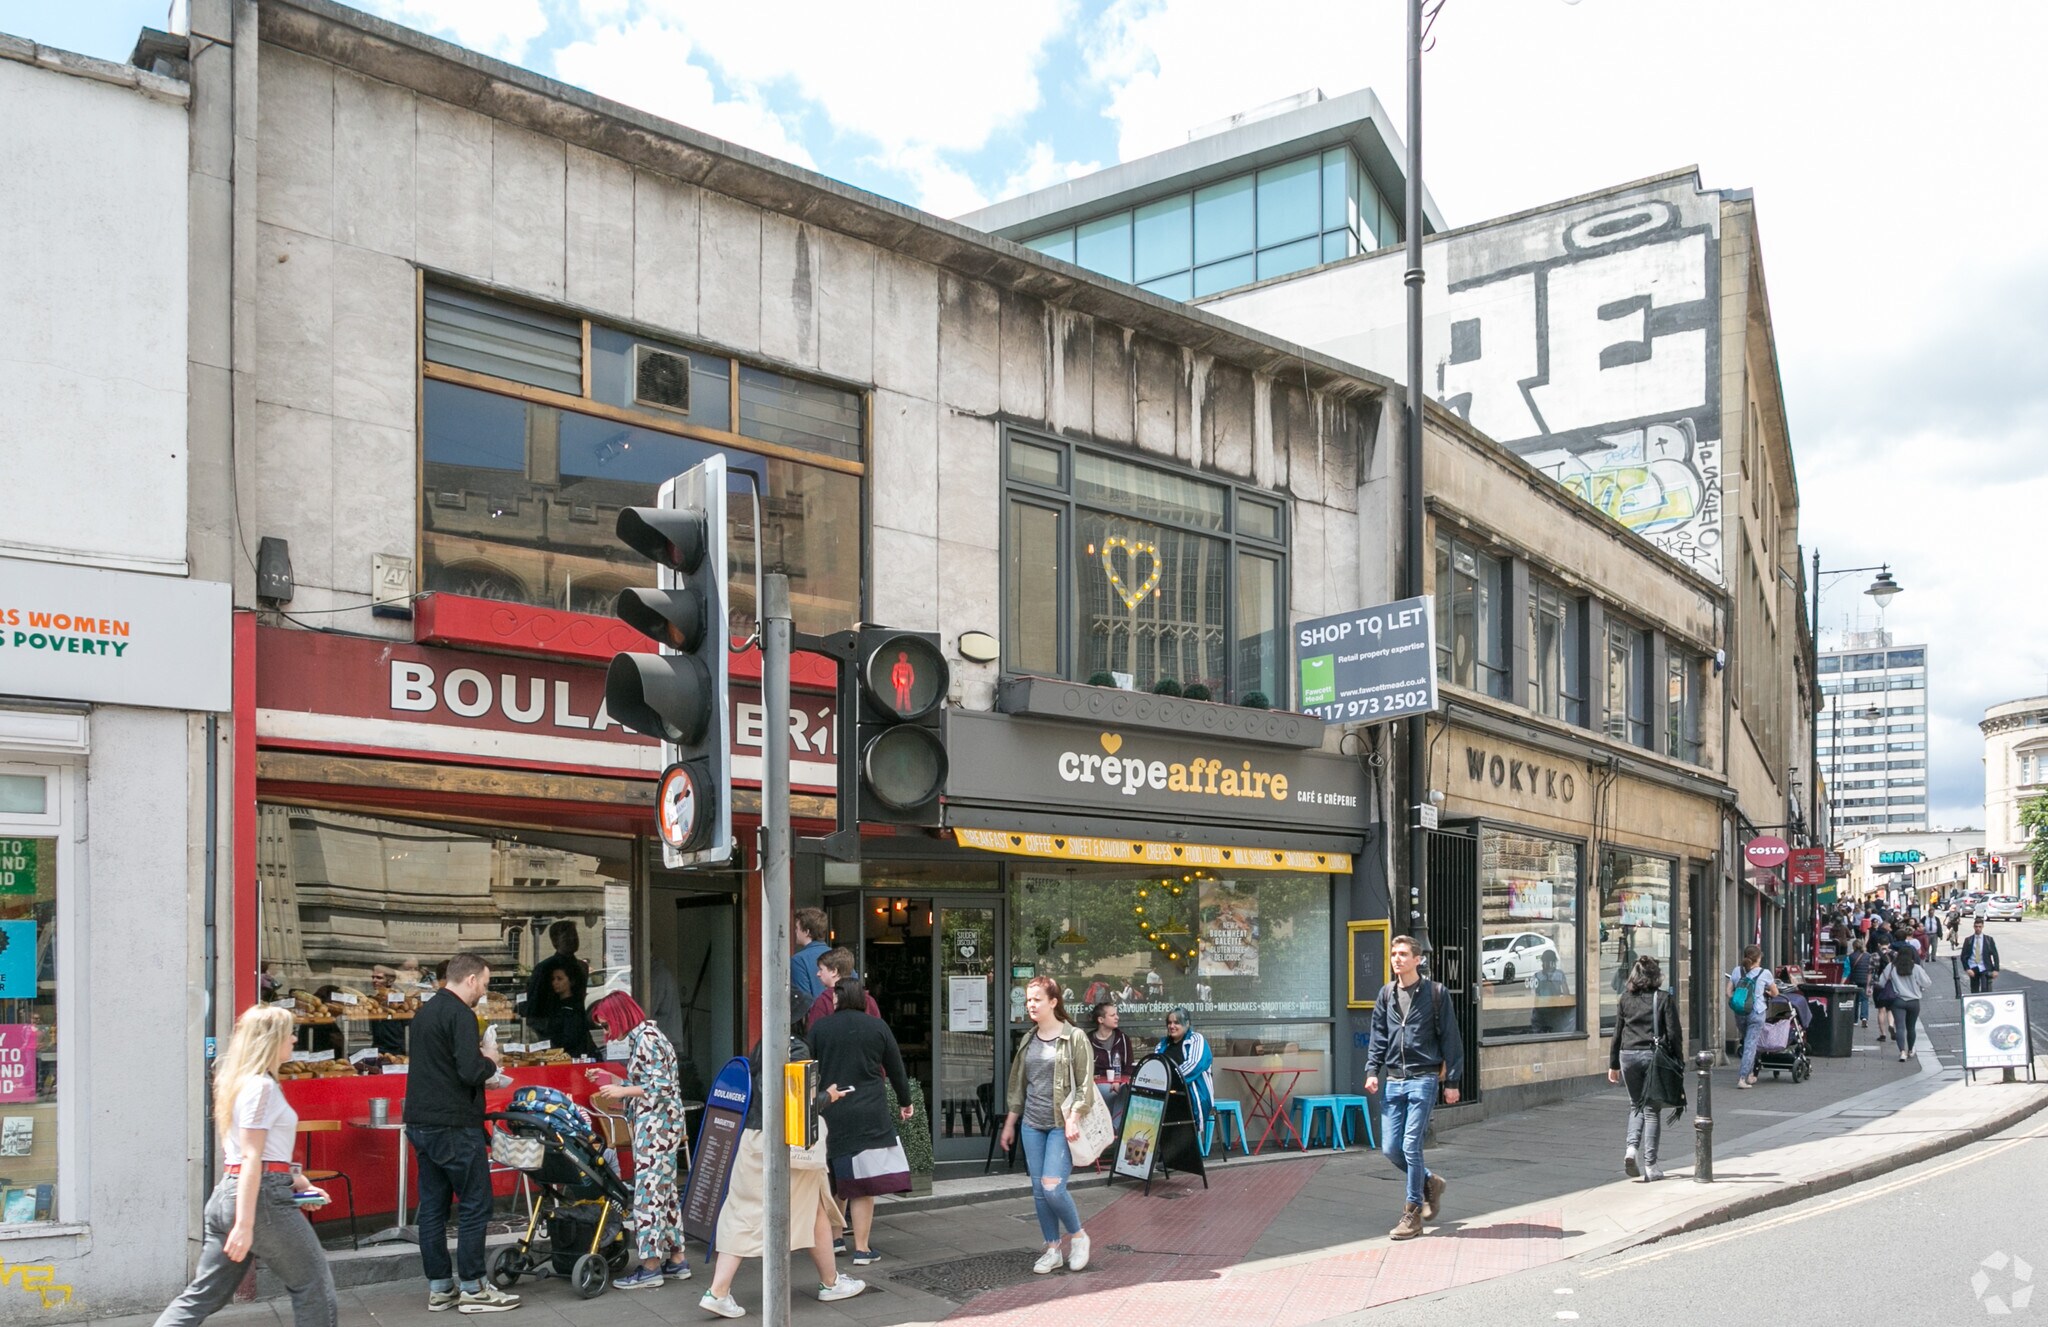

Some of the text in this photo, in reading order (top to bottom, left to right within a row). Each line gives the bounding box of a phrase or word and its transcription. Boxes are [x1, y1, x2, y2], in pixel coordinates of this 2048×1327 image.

[28, 611, 130, 636] WOMEN
[1300, 607, 1424, 647] SHOP TO LET
[14, 631, 129, 657] POVERTY
[1338, 642, 1425, 664] Retail property expertise
[1305, 685, 1333, 696] Fawcett
[1340, 677, 1427, 698] www.fawcettmead.co.uk
[1347, 697, 1380, 717] 973
[1383, 690, 1428, 711] 2502
[1466, 746, 1575, 803] WOKYKO
[1297, 790, 1357, 807] CAFÉ & CRÊPERIE
[0, 840, 22, 855] TO
[963, 829, 1009, 849] BREAKFAST
[1025, 834, 1052, 854] COFFEE
[1068, 837, 1092, 856] SWEET
[1093, 841, 1098, 857] &
[1099, 842, 1131, 859] SAVOURY
[1184, 845, 1202, 863] FOOD
[1202, 847, 1210, 864] TO
[1211, 848, 1221, 864] GO
[1285, 855, 1317, 869] SMOOTHIES
[1328, 858, 1347, 870] LUNCH
[1748, 847, 1785, 855] COSTA
[956, 931, 978, 939] STUDENT
[1209, 930, 1248, 938] BUCKWHEAT
[1215, 937, 1243, 945] GALETTE
[1118, 1002, 1148, 1013] SAVOURY
[1195, 1002, 1203, 1012] TO
[1217, 1002, 1258, 1011] MILKSHAKES
[1260, 1001, 1296, 1011] SMOOTHIES
[0, 1048, 21, 1062] TO
